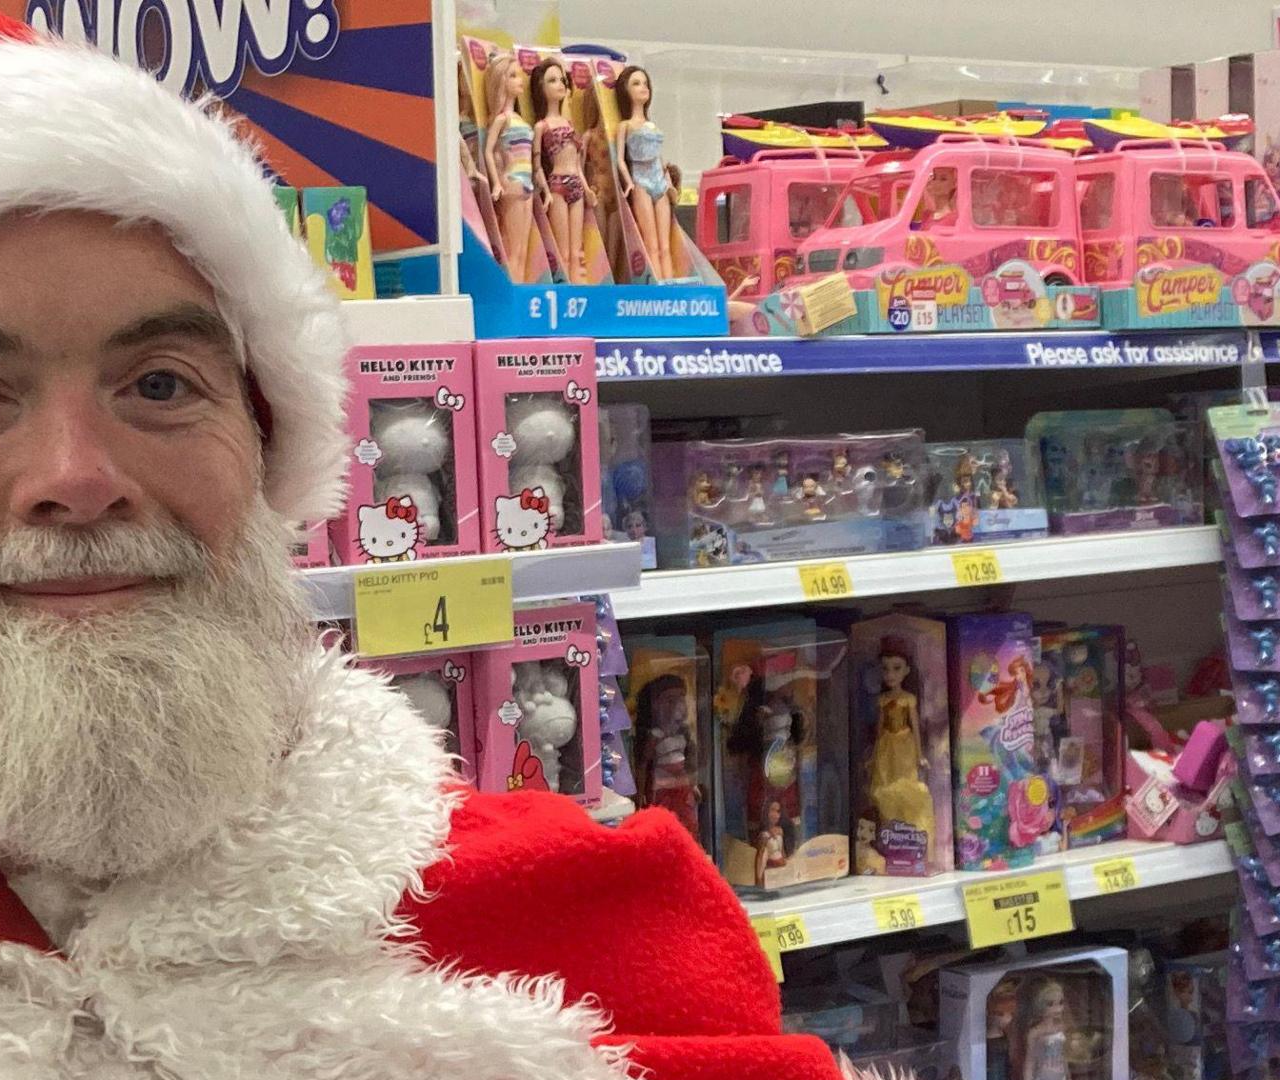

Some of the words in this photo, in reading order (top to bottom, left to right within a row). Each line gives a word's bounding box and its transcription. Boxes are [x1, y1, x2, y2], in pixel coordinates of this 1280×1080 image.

[1140, 269, 1216, 306] Camper
[616, 298, 688, 317] SWIMWEAR
[690, 298, 721, 316] DOLL
[937, 304, 985, 324] PLAYSET
[1190, 302, 1235, 321] PLAYSET
[497, 355, 539, 368] HELLO
[541, 353, 583, 367] KITTY
[1026, 341, 1088, 365] Please
[1091, 341, 1121, 364] ask
[1124, 340, 1149, 362] for
[1153, 338, 1238, 362] assistance
[359, 361, 406, 373] HELLO
[409, 358, 455, 372] KITTY
[518, 368, 534, 377] AND
[536, 367, 567, 376] FRIENDS
[595, 354, 629, 376] ask
[634, 350, 667, 375] for
[671, 349, 783, 375] assistance
[382, 374, 401, 383] AND
[401, 373, 436, 382] FRIENDS
[357, 574, 388, 588] HELLO
[389, 572, 417, 586] KITTY
[417, 570, 439, 584] PYO
[424, 595, 450, 646] £4
[514, 621, 541, 638] ELLO
[544, 619, 583, 634] KITTY
[522, 637, 538, 646] AND
[539, 634, 568, 645] FRIENDS
[1005, 905, 1037, 936] £15
